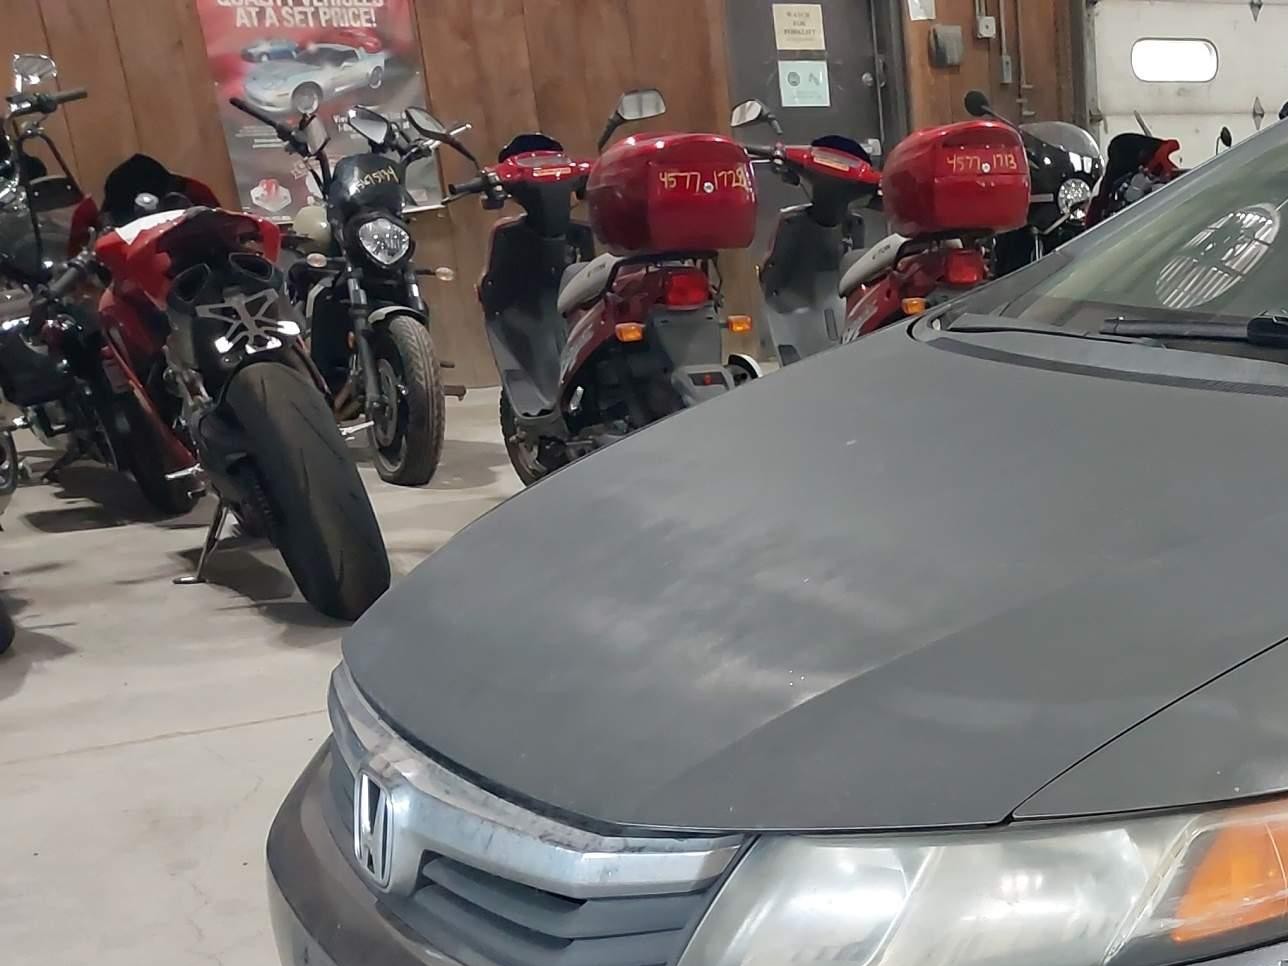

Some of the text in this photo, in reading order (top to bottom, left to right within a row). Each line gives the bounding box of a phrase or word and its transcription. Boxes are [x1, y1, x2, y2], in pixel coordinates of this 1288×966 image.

[236, 6, 378, 28] AT A SET PRICE!
[947, 153, 1017, 173] 4577 1713
[658, 171, 701, 193] 4577
